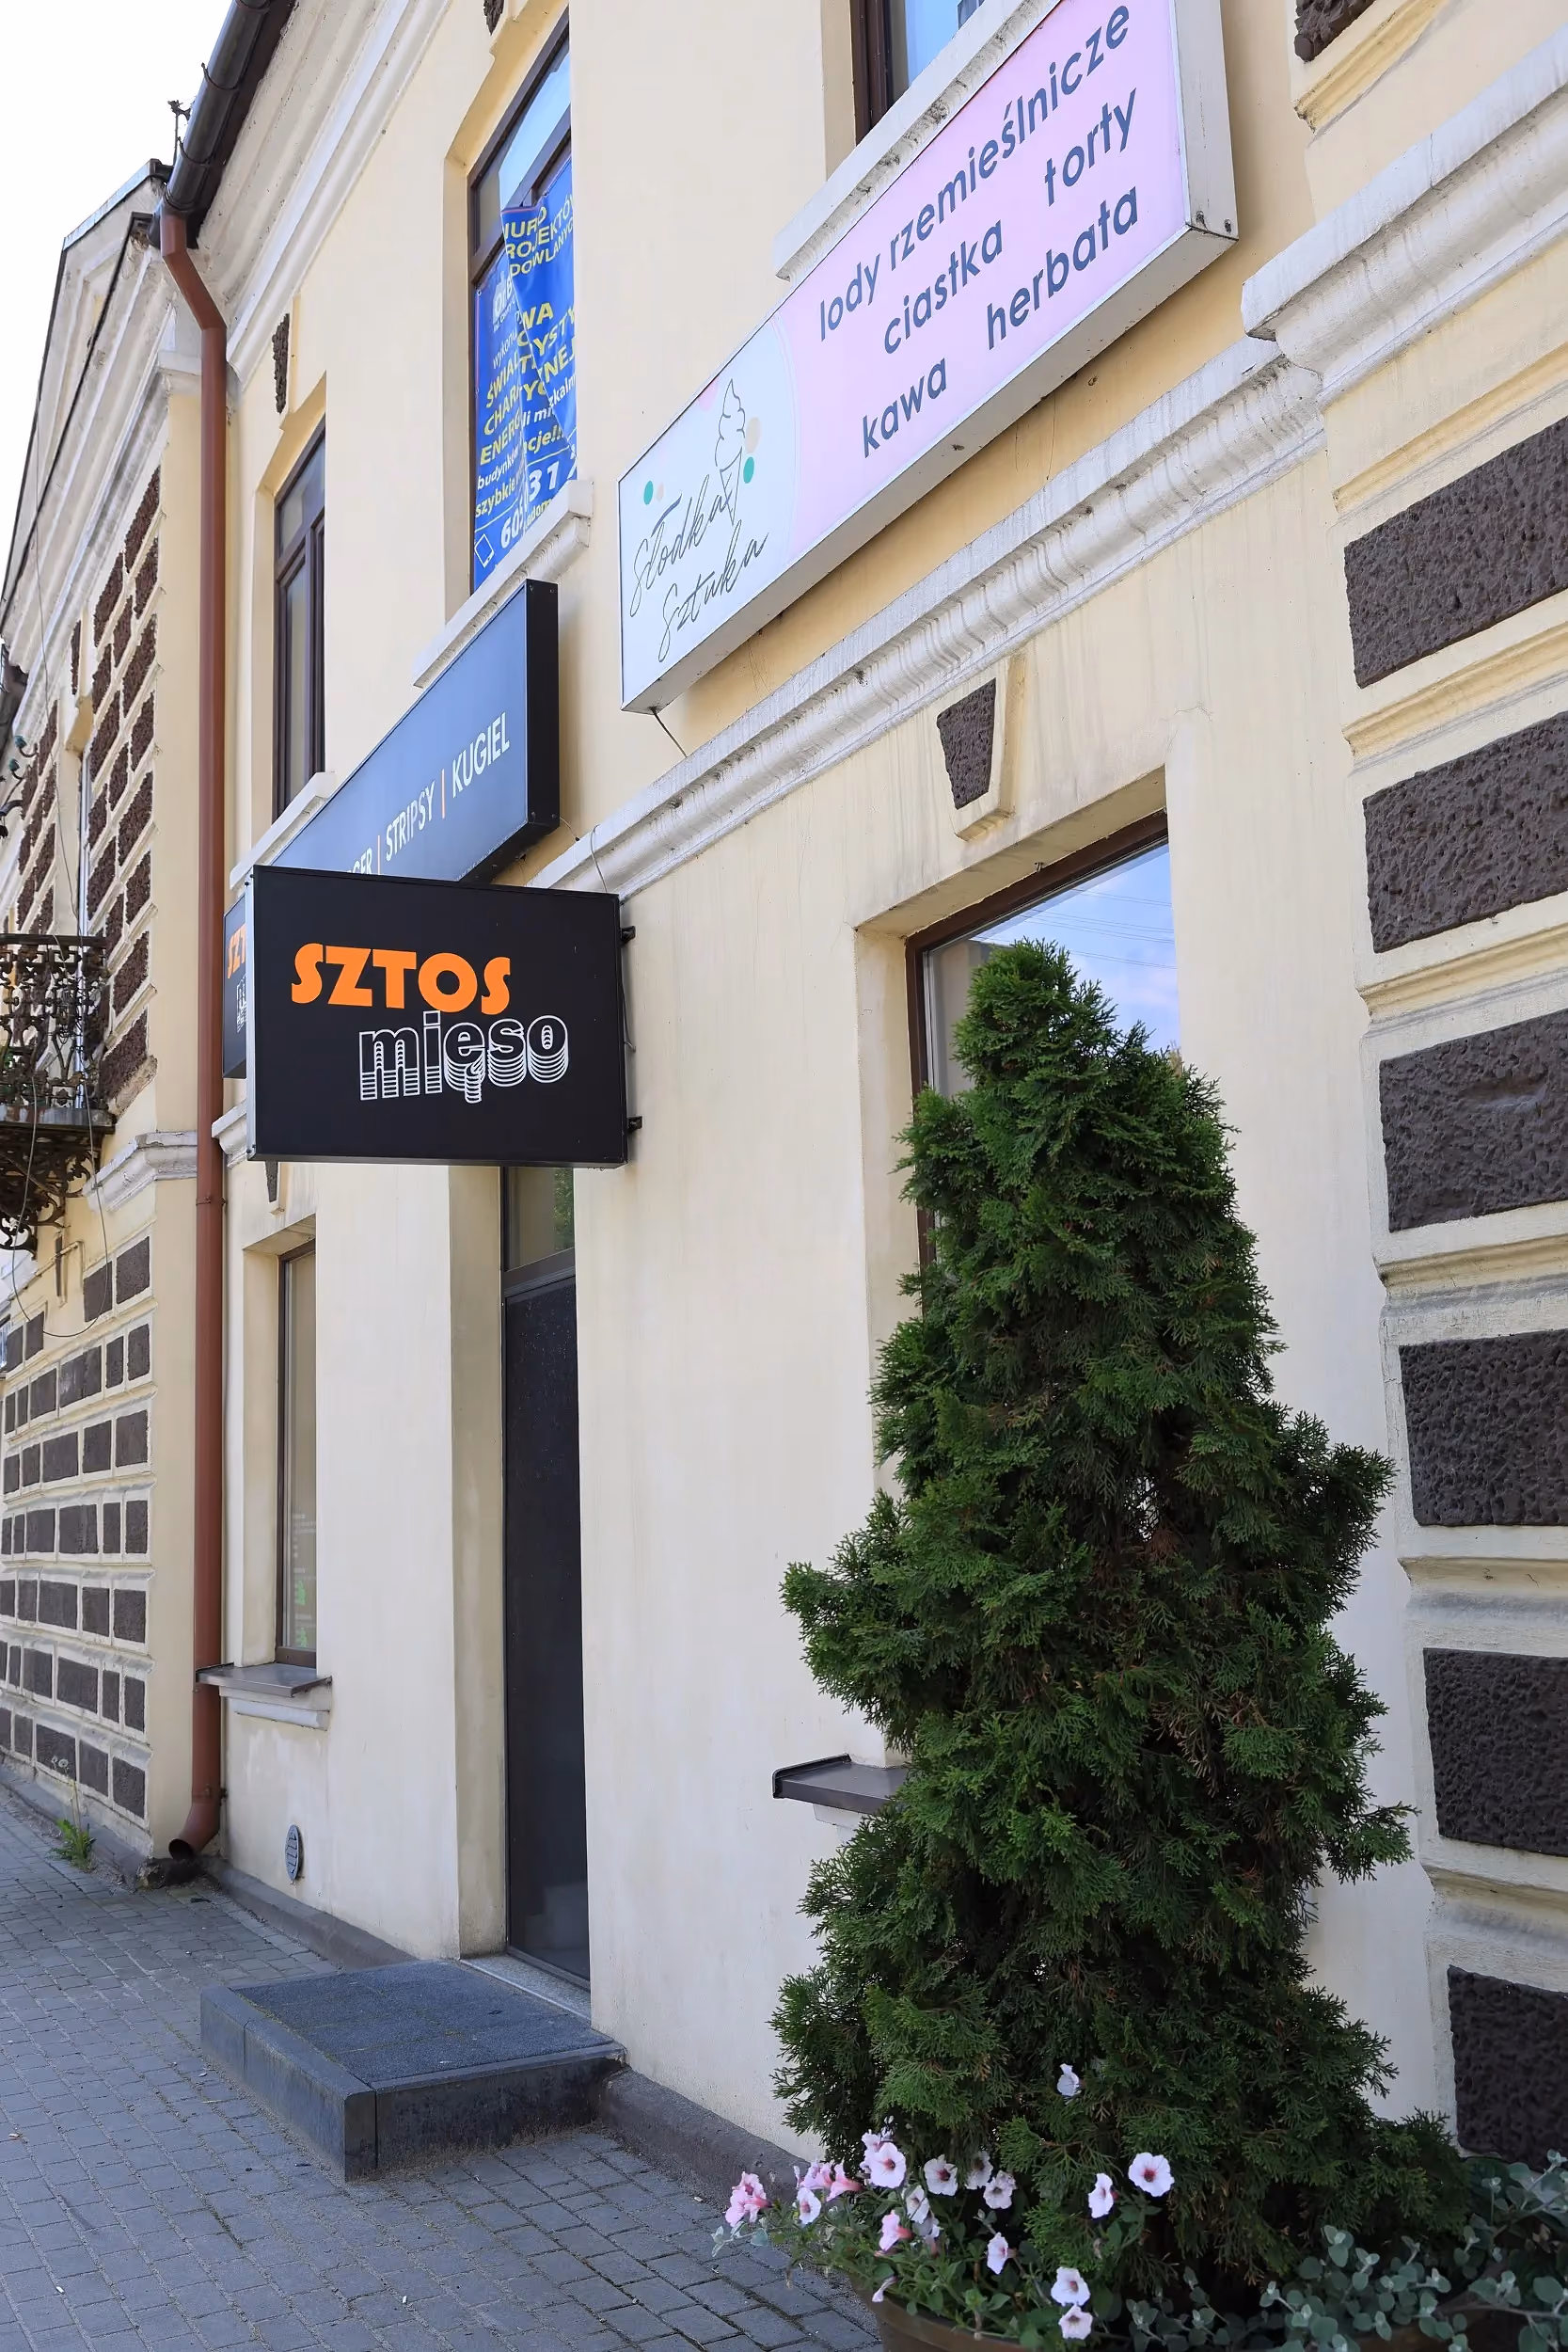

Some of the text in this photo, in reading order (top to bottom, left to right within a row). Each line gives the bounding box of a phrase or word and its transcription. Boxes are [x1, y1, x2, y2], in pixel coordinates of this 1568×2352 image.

[819, 5, 1130, 342] lody rzemieślnicze
[884, 87, 1137, 355] ciastka torty
[863, 185, 1138, 458] kawa herbata
[658, 518, 769, 663] Sztuka
[386, 779, 436, 862] STRIPSY
[451, 711, 511, 799] KUGIEL
[292, 942, 511, 1016] SZTOS
[358, 1009, 570, 1104] mięso
